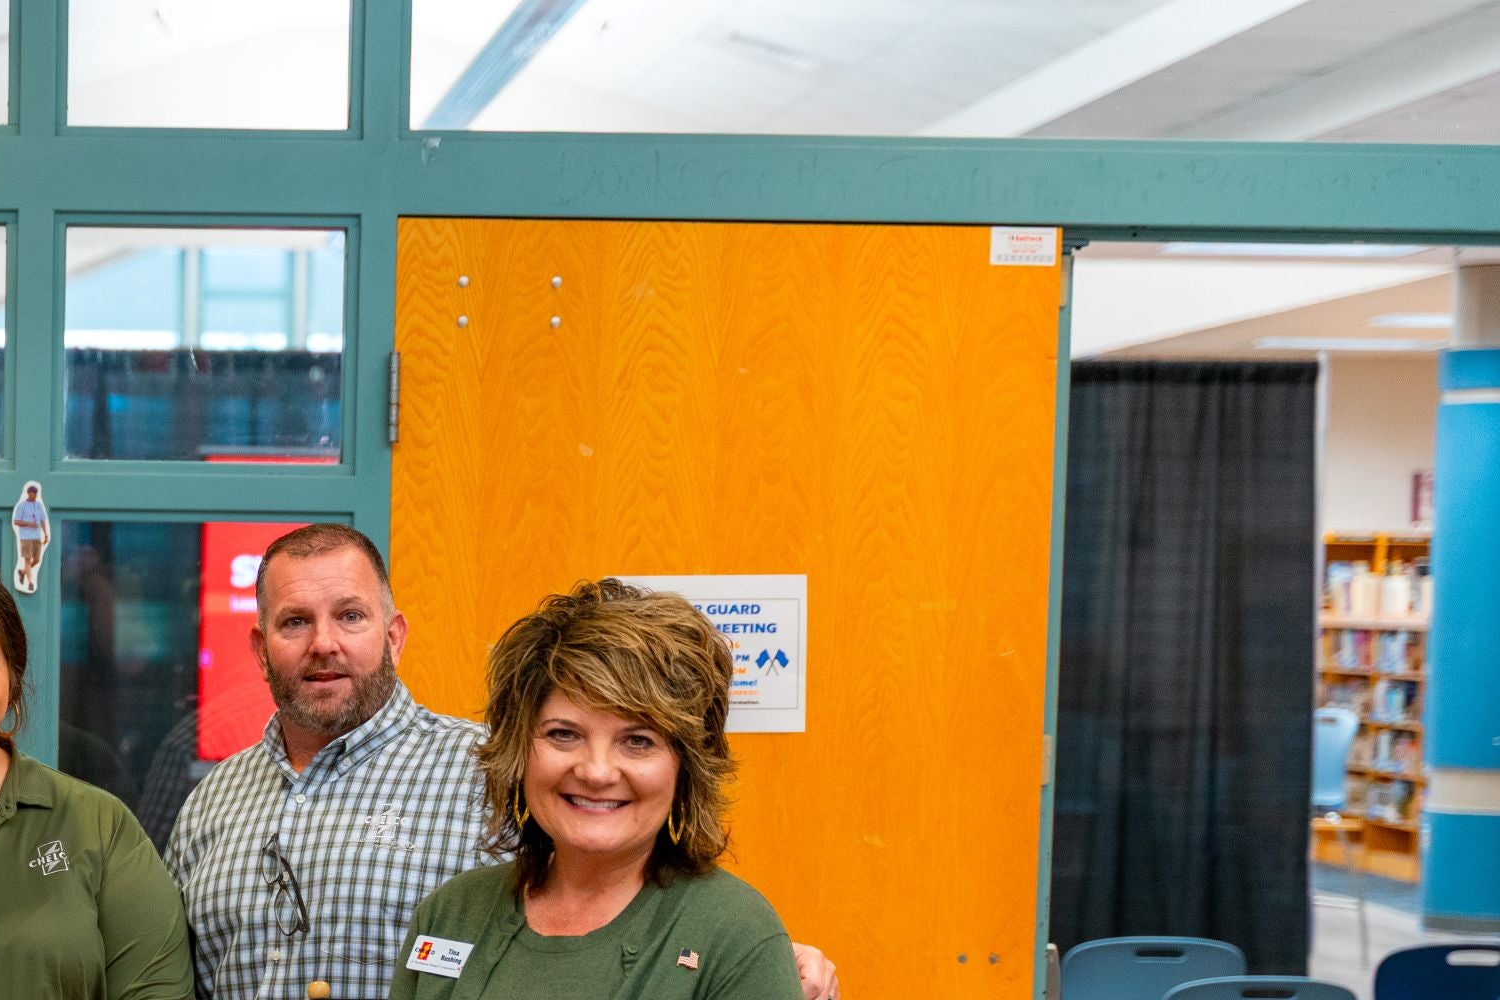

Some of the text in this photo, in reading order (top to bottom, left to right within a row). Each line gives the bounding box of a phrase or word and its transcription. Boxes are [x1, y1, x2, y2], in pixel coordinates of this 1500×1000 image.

[706, 604, 760, 615] GUARD
[735, 654, 750, 662] PM
[29, 852, 70, 868] CHELC
